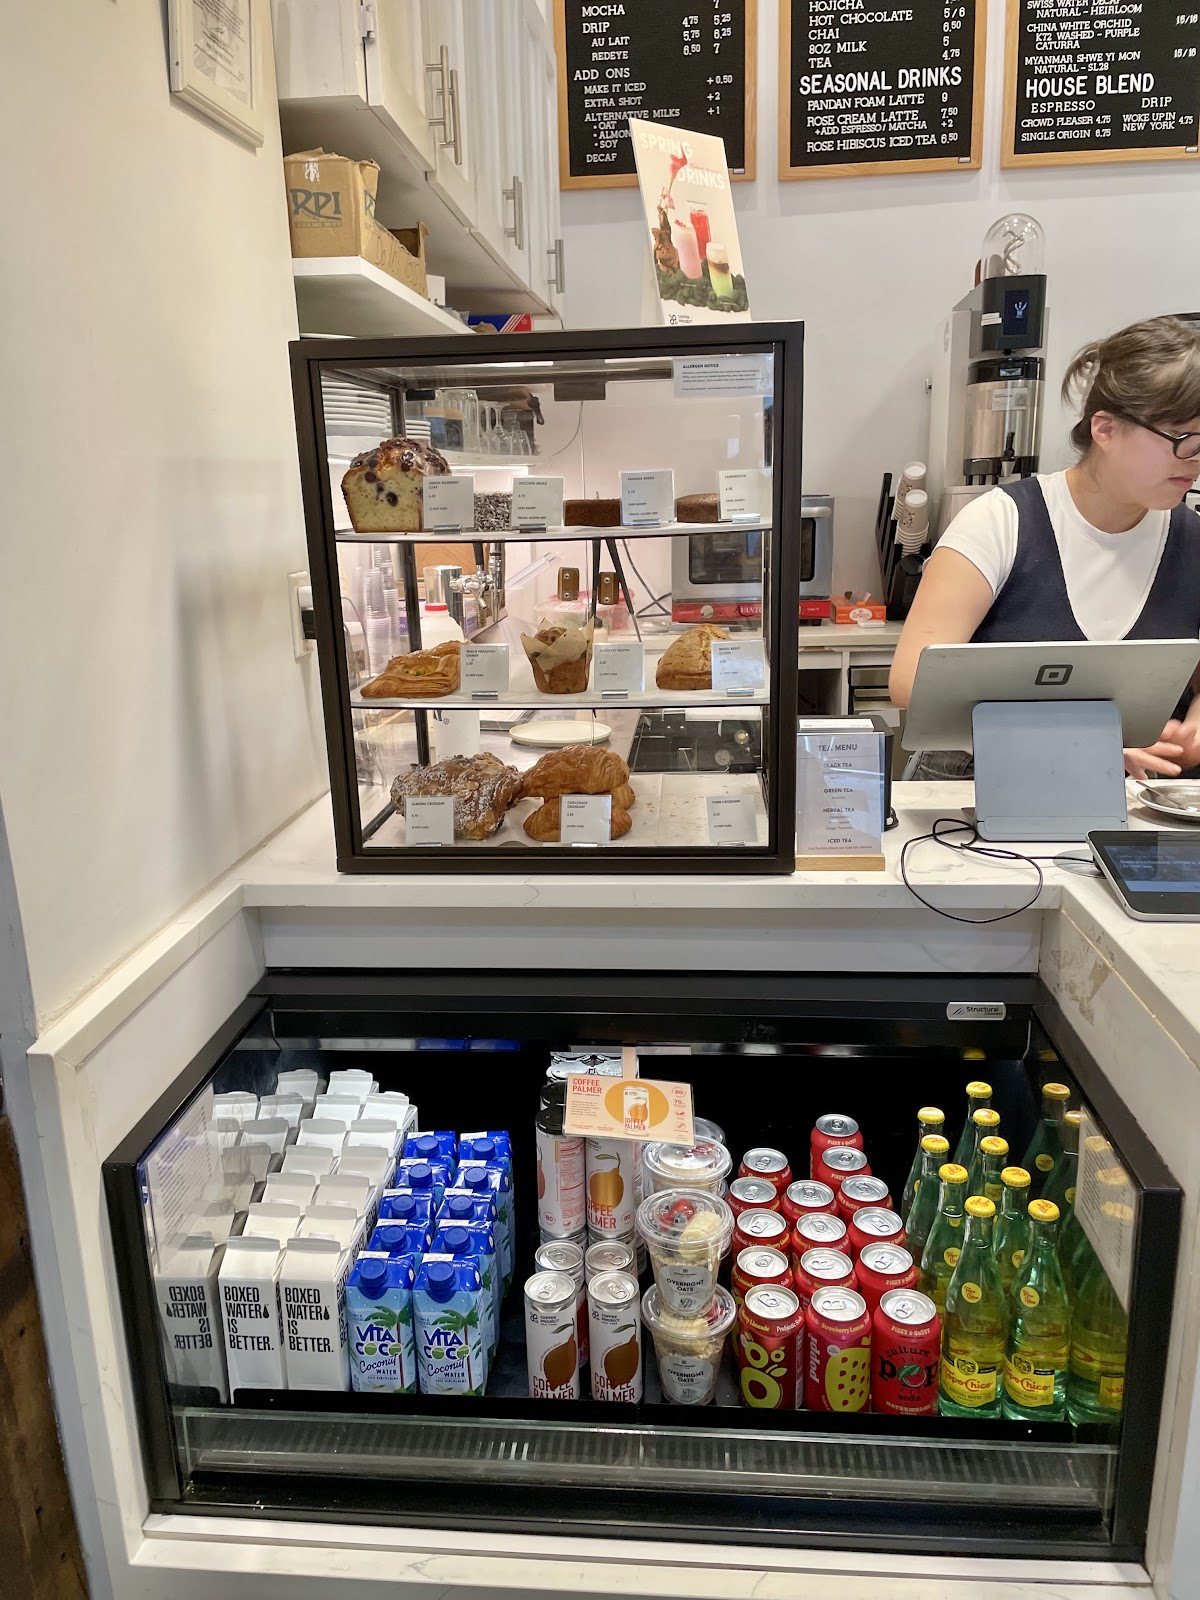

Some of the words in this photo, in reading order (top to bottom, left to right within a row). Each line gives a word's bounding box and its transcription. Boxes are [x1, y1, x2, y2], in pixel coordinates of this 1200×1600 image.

[582, 4, 625, 17] MOCHA
[809, 0, 864, 12] HOJICHA
[1027, 0, 1055, 9] SWISS
[1036, 8, 1081, 18] NATURAL
[1090, 4, 1142, 15] HEIRLOOM
[582, 22, 610, 34] DRIP
[714, 14, 731, 25] 5.25
[809, 15, 834, 26] HOT
[840, 10, 913, 24] CHOCOLATE
[809, 29, 839, 40] CHAI
[943, 21, 961, 32] 6.50
[1027, 24, 1057, 32] CHINA
[1059, 21, 1090, 31] WHITE
[1093, 19, 1132, 29] ORCHID
[591, 38, 605, 47] AU
[609, 36, 630, 46] LAIT
[683, 30, 700, 42] 5.75
[714, 28, 731, 39] 6.25
[1036, 33, 1052, 42] K72
[1057, 30, 1094, 40] WASHED
[1104, 28, 1140, 38] PURPLE
[836, 41, 867, 53] MILK
[943, 36, 949, 47] 5
[1036, 40, 1080, 50] CATURRA
[592, 51, 628, 61] REDEYE
[683, 44, 701, 55] 6.50
[714, 43, 720, 54] 7
[808, 57, 832, 68] TEA
[942, 49, 960, 60] 4.75
[1025, 54, 1073, 65] MYANMAR
[1077, 53, 1103, 63] SHWE
[1106, 52, 1115, 61] YI
[1118, 51, 1141, 61] MON
[574, 70, 599, 81] ADD
[606, 68, 630, 78] ONS
[1034, 64, 1079, 74] NATURAL
[1088, 63, 1109, 72] SL28
[799, 71, 892, 95] SEASONAL
[898, 66, 962, 88] DRINKS
[1026, 76, 1088, 98] HOUSE
[1096, 73, 1154, 95] BLEND
[584, 86, 609, 94] MAKE
[612, 84, 621, 93] IT
[625, 83, 646, 92] ICED
[585, 99, 615, 108] EXTRA
[619, 97, 642, 105] SHOT
[807, 98, 852, 111] PANDAN
[854, 96, 885, 108] FOAM
[889, 94, 924, 106] LATTE
[941, 92, 948, 102] 9
[1031, 100, 1095, 113] ESPRESSO
[1141, 97, 1172, 108] DRIP
[585, 110, 649, 122] ALTERNATIVE
[653, 109, 680, 118] MILKS
[807, 116, 834, 127] ROSE
[837, 113, 876, 125] CREAM
[880, 110, 919, 122] LATTE
[941, 107, 958, 118] 7.50
[1021, 119, 1054, 128] CROWD
[1056, 117, 1093, 126] PLEASER
[1096, 115, 1111, 124] 4.75
[1122, 113, 1149, 122] WOKE
[1152, 113, 1164, 122] UP
[889, 121, 927, 131] MATCHA
[1122, 123, 1146, 132] NEW
[1150, 122, 1175, 130] YORK
[807, 141, 834, 152] ROSE
[837, 137, 886, 150] HIBISCUS
[889, 136, 913, 147] ICED
[916, 135, 937, 145] TEA
[941, 133, 958, 144] 6.50
[1021, 132, 1055, 141] SINGLE
[1057, 130, 1091, 139] ORIGIN
[600, 141, 618, 149] SOY
[639, 134, 693, 158] SPRING
[587, 153, 617, 162] DECAF
[677, 167, 726, 190] DRINKS
[290, 189, 342, 220] RPI
[572, 1085, 602, 1094] PALMER
[573, 1078, 600, 1087] COFFEE
[667, 1278, 704, 1287] OVERNIGHT
[224, 1286, 259, 1303] BOXED
[285, 1287, 320, 1303] BOXED
[226, 1302, 262, 1319] WATER
[286, 1304, 323, 1320] WATER
[228, 1318, 238, 1334] IS
[287, 1320, 298, 1335] IS
[821, 1323, 850, 1334] Strawberry
[850, 1324, 864, 1333] Lemon
[891, 1326, 908, 1335] FIZZY
[356, 1324, 395, 1343] VITA
[423, 1328, 463, 1347] VITA
[229, 1335, 274, 1351] BETTER.
[289, 1336, 334, 1352] BETTER.
[355, 1342, 402, 1356] COCO
[424, 1345, 470, 1360] COCO
[886, 1346, 930, 1358] culture
[359, 1354, 397, 1373] Coconut
[427, 1357, 465, 1377] Coconut
[668, 1368, 704, 1378] OVERNIGHT
[965, 1378, 994, 1392] Chico
[1020, 1378, 1050, 1392] Chico
